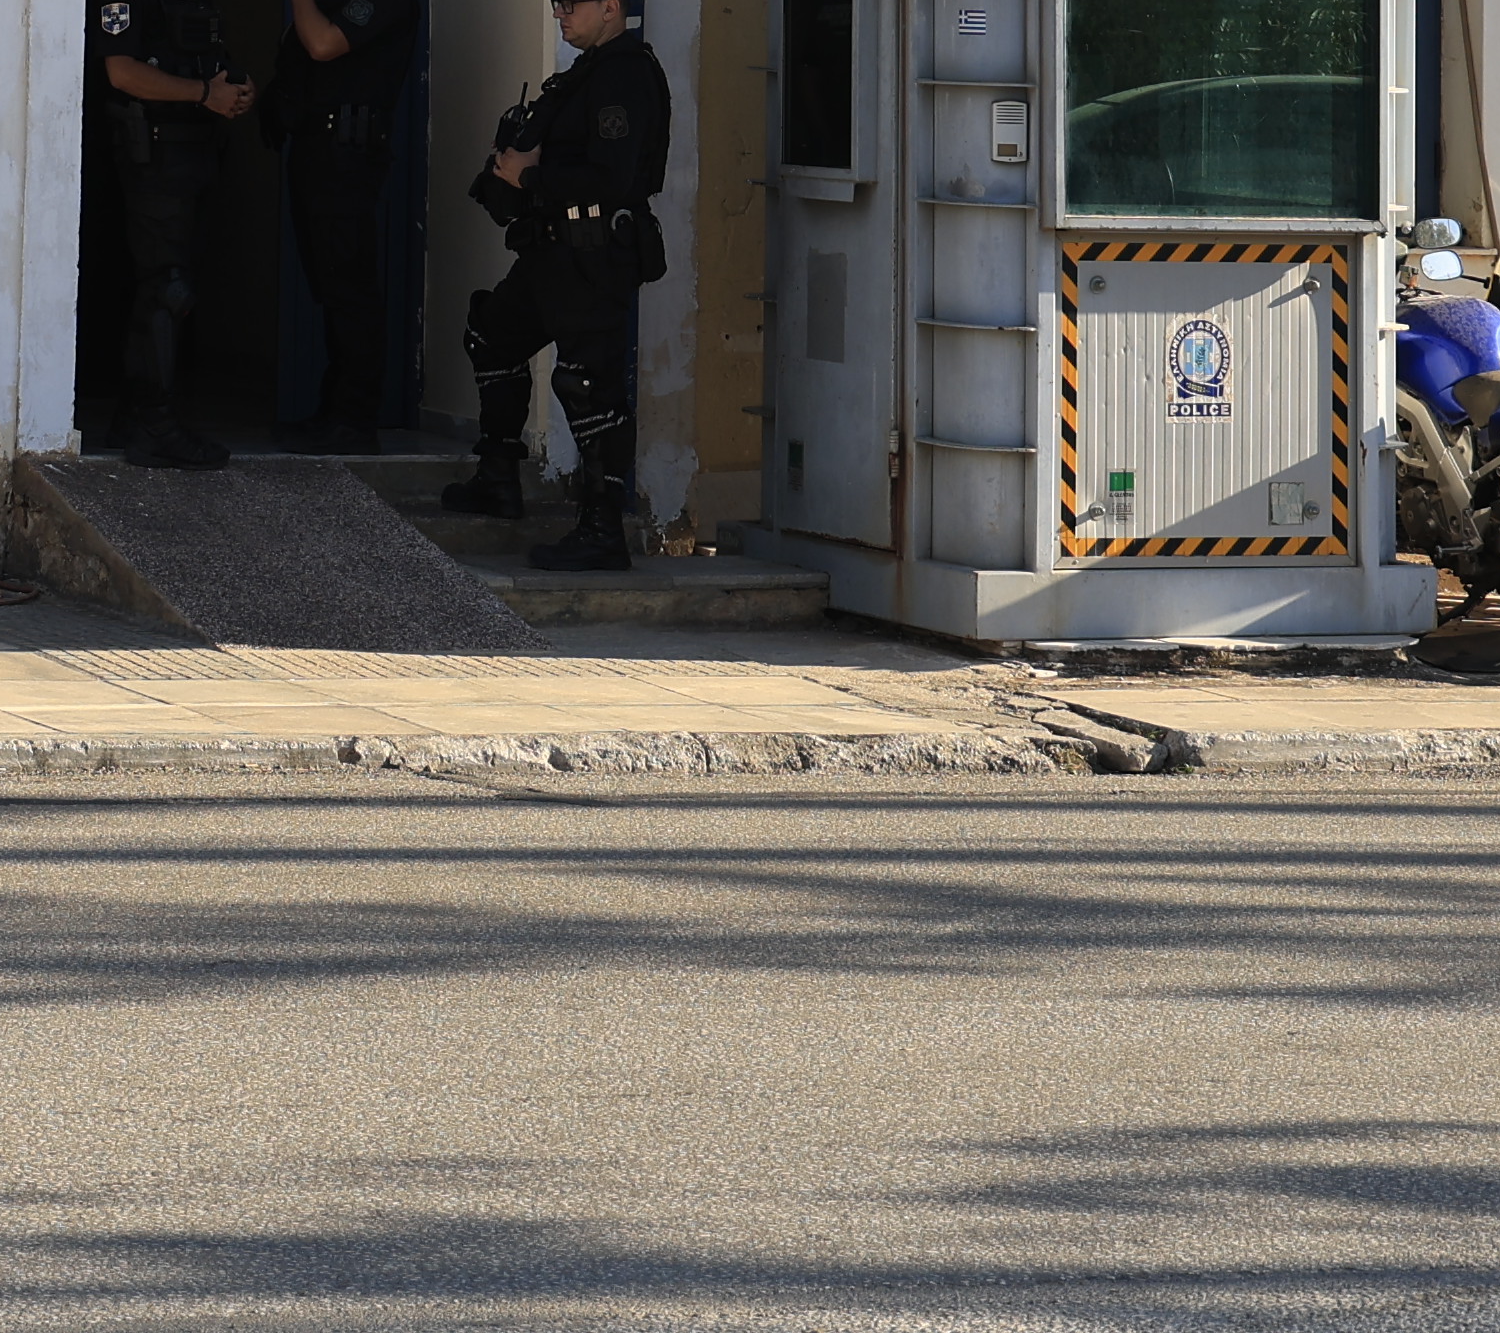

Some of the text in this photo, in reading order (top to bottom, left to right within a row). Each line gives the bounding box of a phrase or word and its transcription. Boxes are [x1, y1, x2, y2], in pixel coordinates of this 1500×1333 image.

[1170, 321, 1230, 383] ΕΛΛΗΝΙΚΗ ΑΣΤΥΝΟΜΙΑ
[1169, 403, 1230, 416] POLICE
